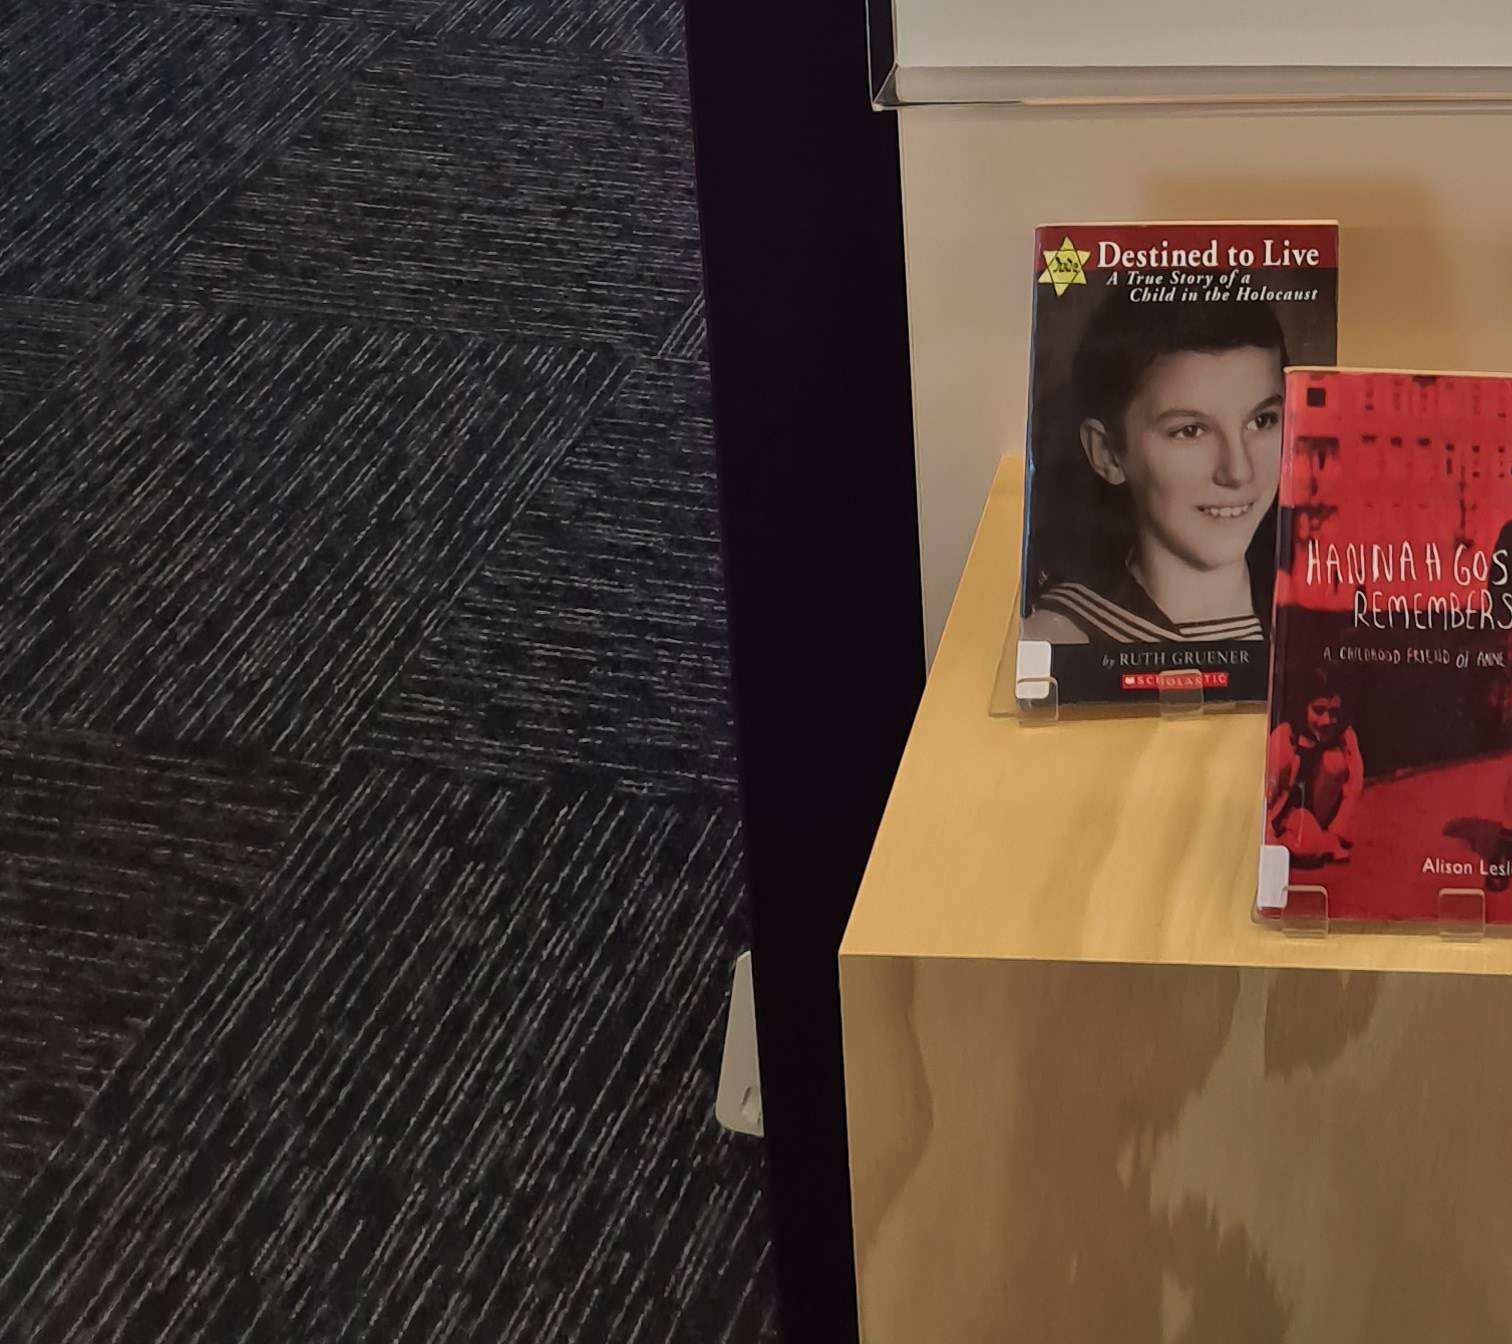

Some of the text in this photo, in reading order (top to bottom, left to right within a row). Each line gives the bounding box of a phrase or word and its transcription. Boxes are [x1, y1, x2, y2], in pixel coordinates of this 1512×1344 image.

[1097, 240, 1320, 268] Destined to Live
[1106, 268, 1251, 289] A True Story of a
[1130, 287, 1318, 302] Child in the Holocaust
[1306, 538, 1442, 586] HANNAH
[1102, 649, 1251, 670] by RUTH GRUENER
[1323, 647, 1332, 660] A
[1339, 646, 1402, 665] CHILDHOOD
[1406, 648, 1451, 665] FRIEND
[1476, 650, 1505, 667] ANNE
[1137, 673, 1227, 687] SCHOLASTIC
[1422, 857, 1473, 875] Alison
